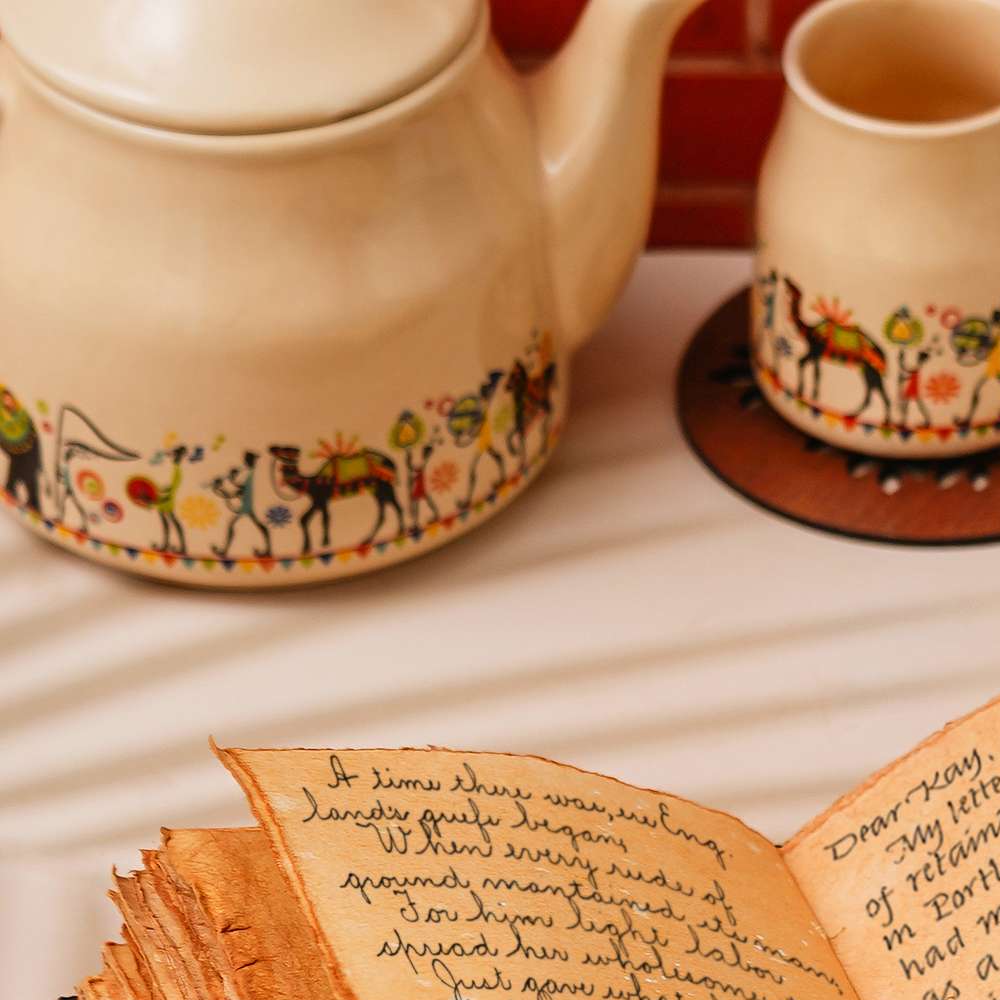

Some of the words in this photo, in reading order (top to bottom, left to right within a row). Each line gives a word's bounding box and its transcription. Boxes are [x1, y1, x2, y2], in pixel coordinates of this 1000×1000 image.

[328, 755, 358, 788] A
[372, 767, 441, 791] time
[450, 763, 532, 800] there
[824, 801, 902, 861] Dear
[886, 819, 944, 865] My
[356, 818, 493, 858] When
[504, 841, 598, 889] every
[702, 880, 736, 926] of
[339, 866, 470, 904] ground
[698, 919, 748, 945] its
[865, 886, 894, 927] of
[377, 928, 498, 975] spread
[505, 924, 569, 962] her
[393, 889, 458, 923] For
[466, 890, 553, 929] him
[565, 900, 669, 956] light
[685, 925, 785, 985] labor
[883, 923, 916, 951] in
[900, 926, 966, 980] had
[976, 954, 999, 980] a
